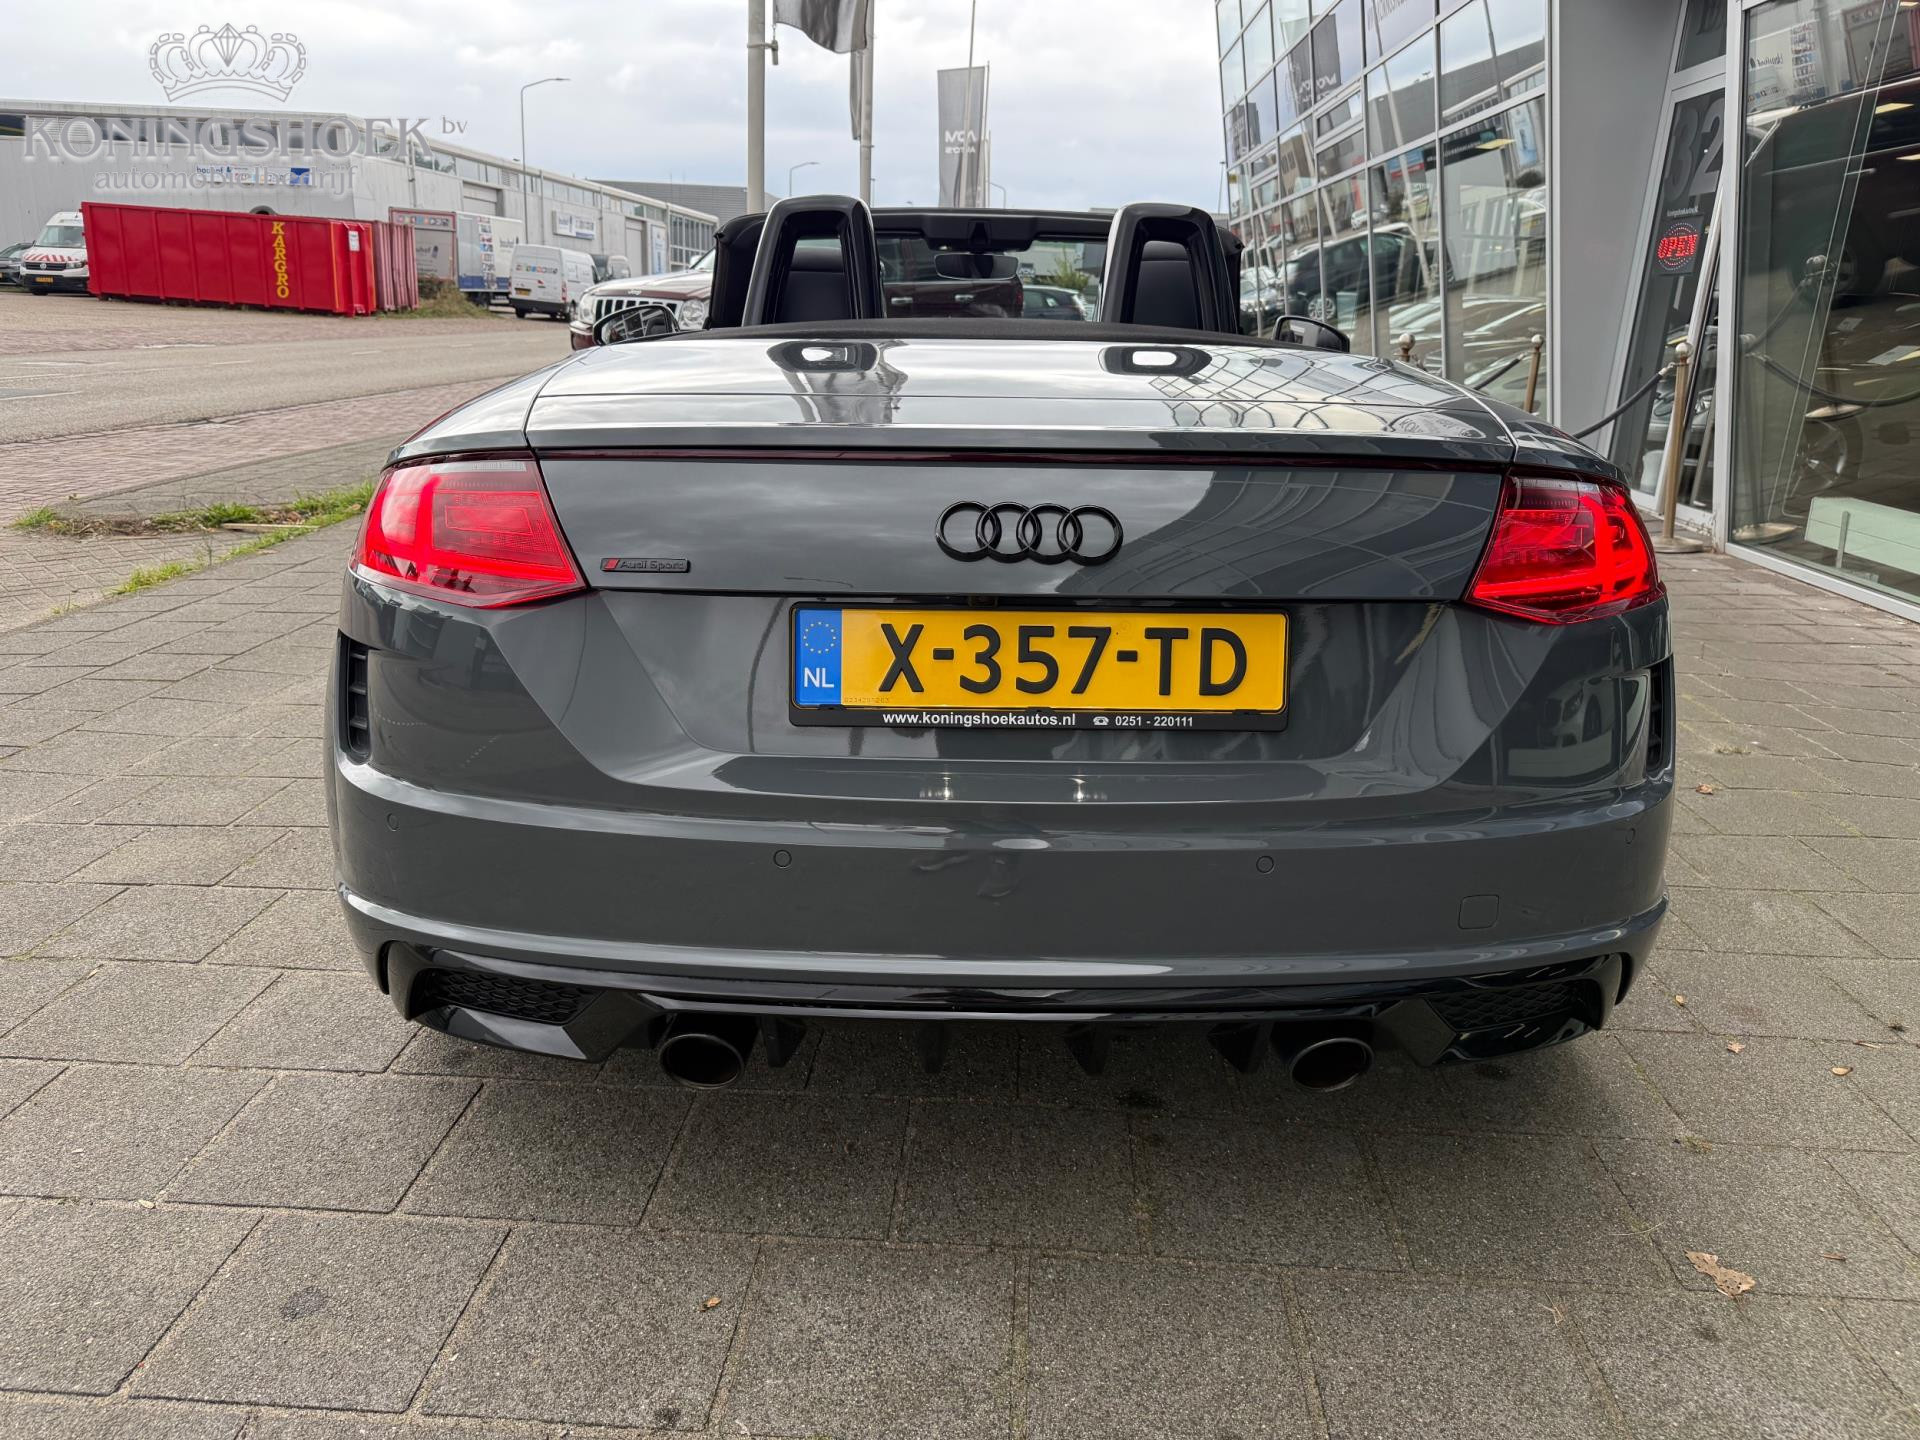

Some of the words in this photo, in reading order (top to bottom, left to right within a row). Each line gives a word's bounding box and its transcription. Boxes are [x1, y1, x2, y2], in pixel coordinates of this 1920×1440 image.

[1658, 234, 1698, 258] OPEN
[272, 221, 289, 298] KARGRO
[620, 560, 647, 569] Audi
[650, 560, 685, 572] Sport
[879, 623, 1247, 696] X-357-TD
[803, 667, 835, 688] NL
[883, 712, 1076, 728] www.koningshoekautos.nl
[1115, 716, 1143, 726] 0251
[1153, 716, 1193, 727] 220111
